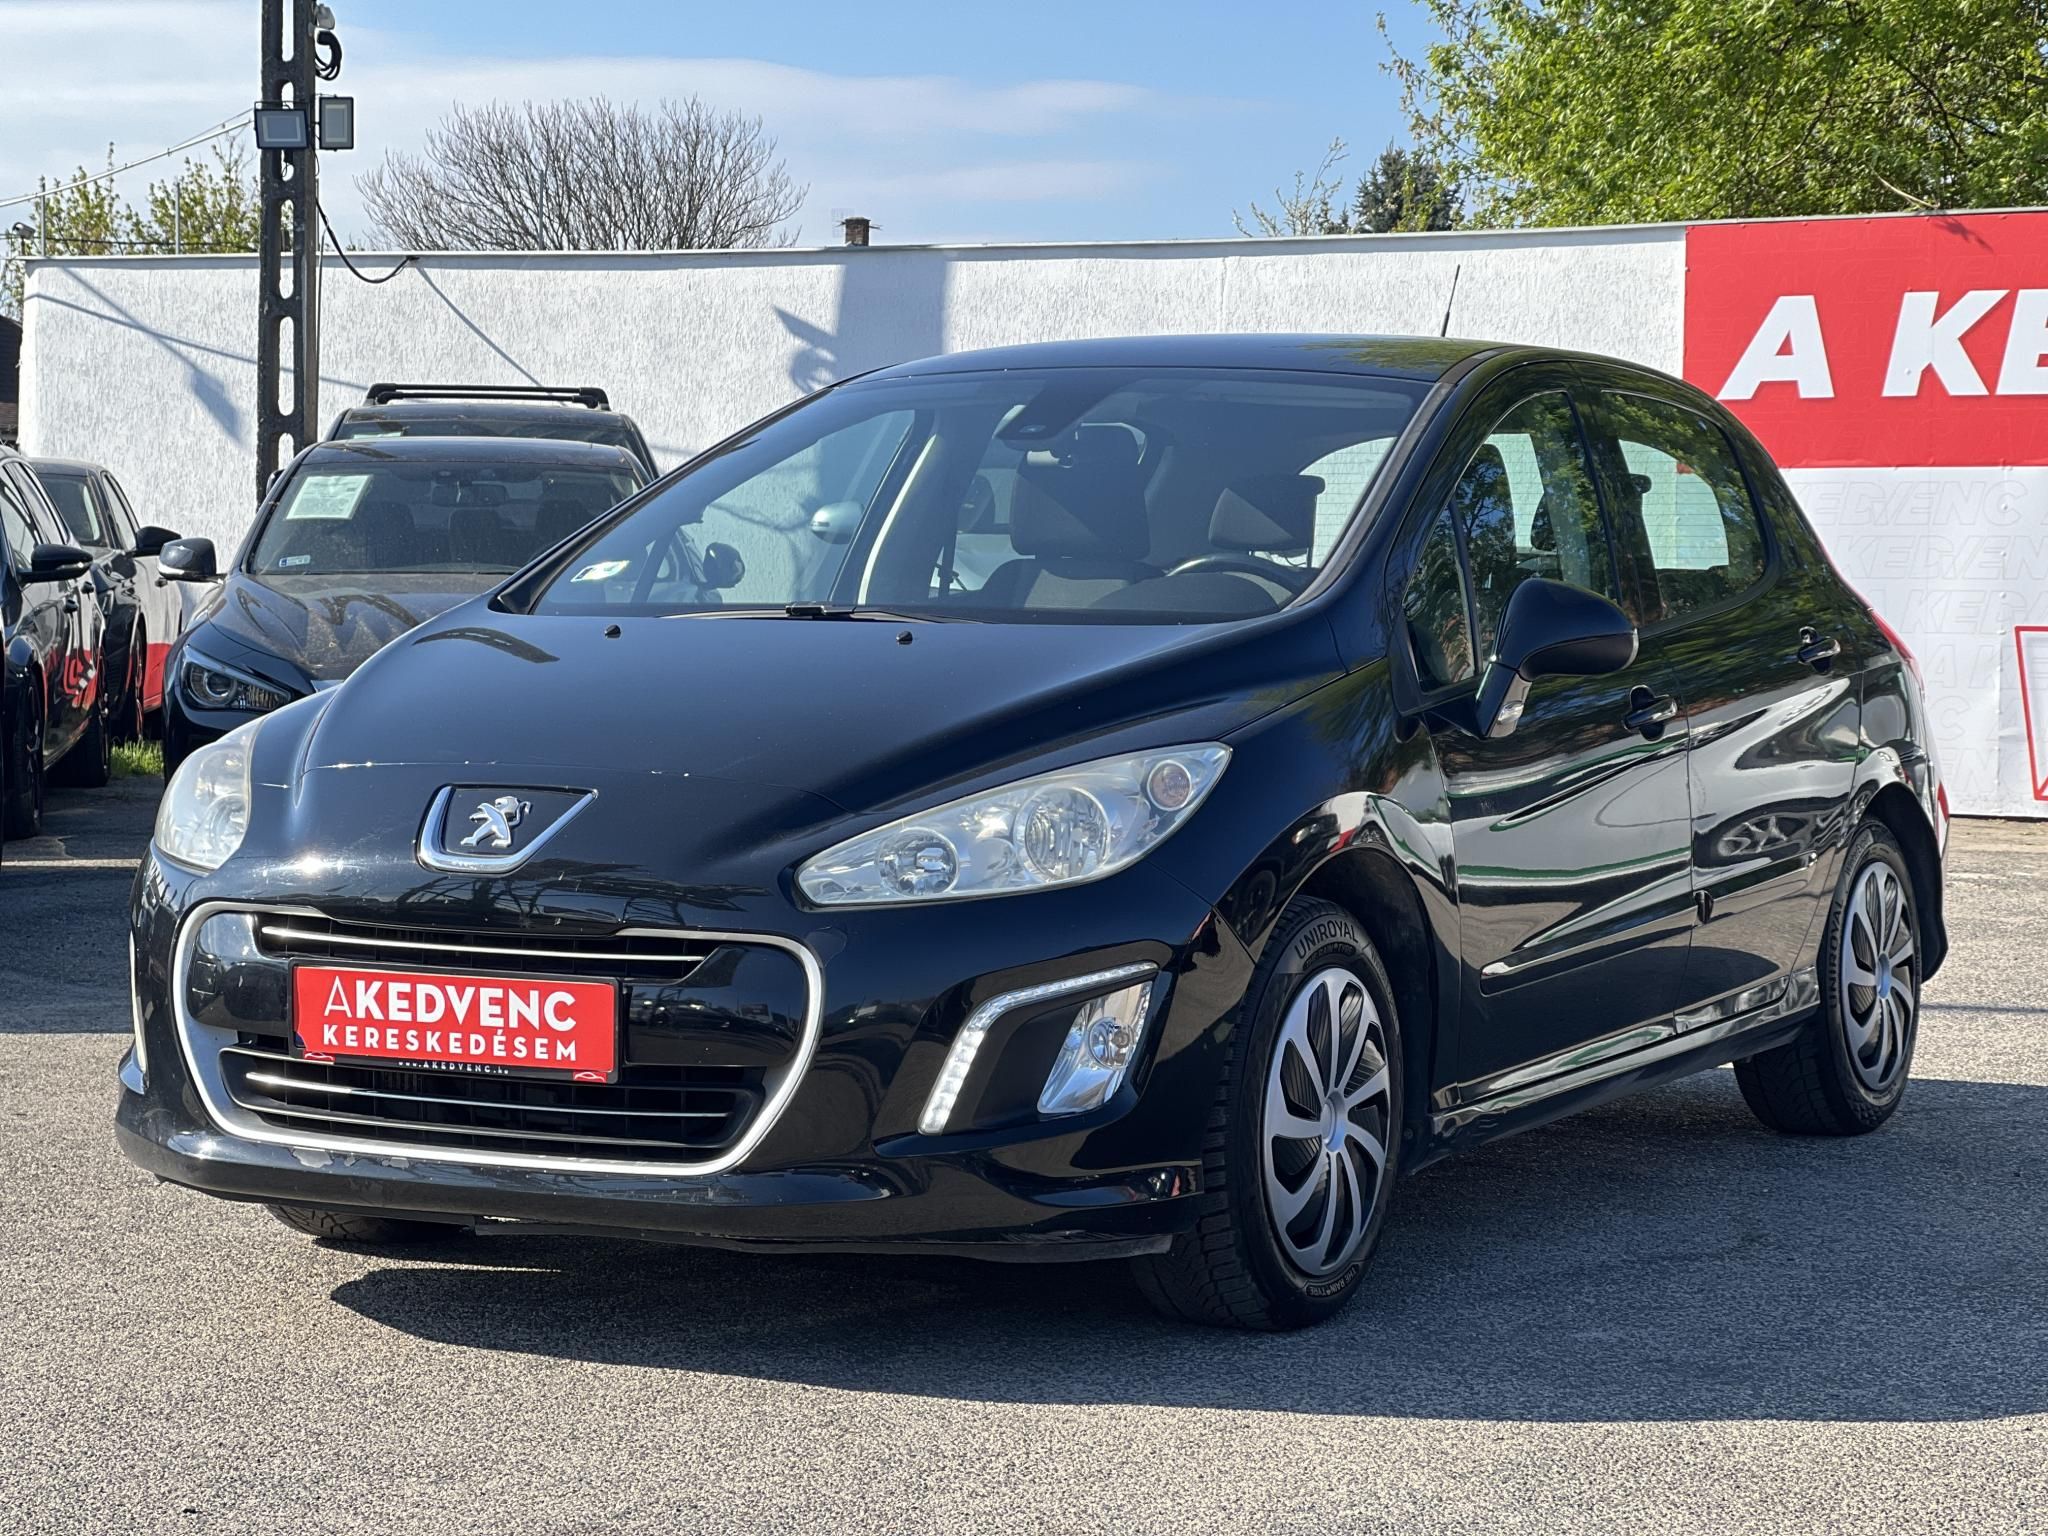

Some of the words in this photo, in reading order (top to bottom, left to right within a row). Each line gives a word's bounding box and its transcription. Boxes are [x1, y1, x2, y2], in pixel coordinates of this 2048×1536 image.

[1715, 294, 1835, 401] A
[1294, 919, 1359, 959] UNIROYAL
[322, 1023, 577, 1062] KERESKEDÉSEM
